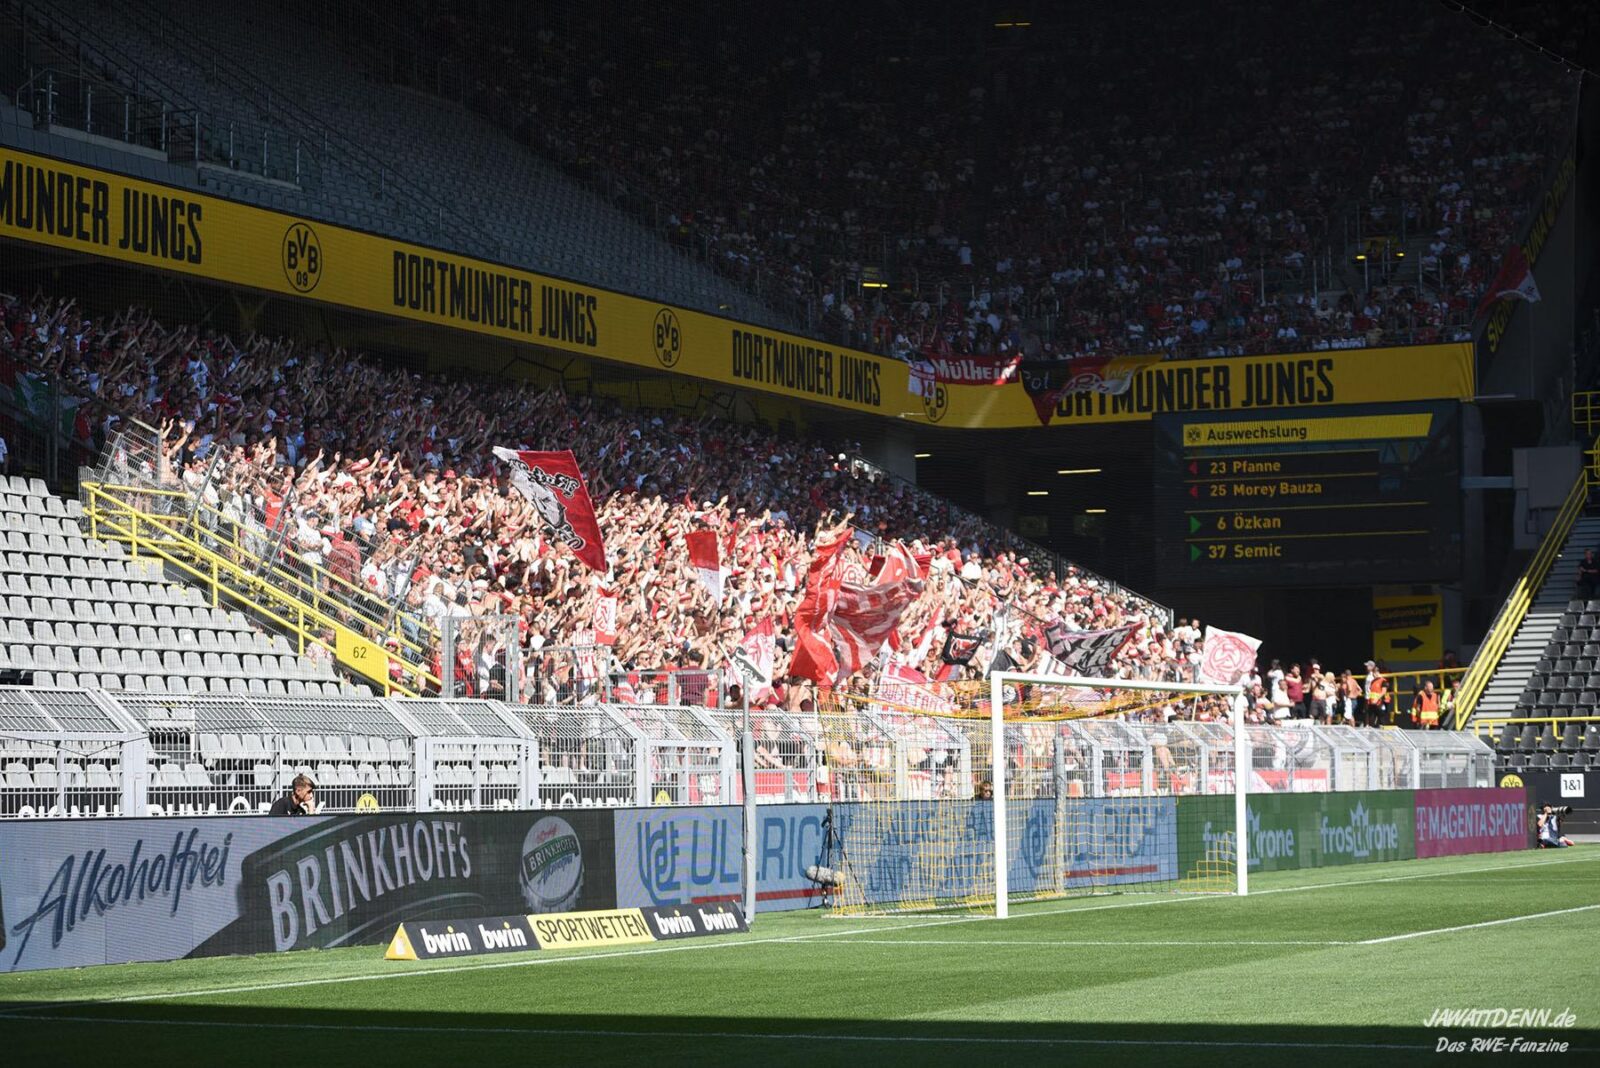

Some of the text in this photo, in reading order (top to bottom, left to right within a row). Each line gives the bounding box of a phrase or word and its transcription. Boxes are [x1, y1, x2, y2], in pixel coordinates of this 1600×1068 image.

[119, 187, 202, 264] JUNGS
[287, 227, 318, 273] BVB
[296, 271, 309, 286] 09
[393, 250, 598, 348] DORTMUNDER JUNGS
[657, 313, 679, 349] BVB
[663, 349, 673, 362] 09
[732, 329, 834, 396] DORTMUNDER
[838, 354, 881, 408] JUNGS
[1241, 359, 1334, 408] JUNGS
[1207, 424, 1307, 442] Auswechslung
[1210, 460, 1281, 474] 23 Pfanne
[1210, 482, 1322, 498] 25 Morey Bauza
[1217, 512, 1282, 530] 6 Özkan
[1208, 543, 1282, 559] 37 Semic
[353, 646, 367, 659] 62
[1563, 779, 1581, 791] 1&1
[1429, 804, 1488, 841] MAGENTA
[1488, 802, 1525, 837] SPORT
[12, 827, 232, 968] Alkoholfrei
[420, 925, 471, 954] bwin
[478, 921, 528, 950] bwin
[536, 913, 649, 944] SPORTWETTEN
[654, 909, 696, 935] bwin
[700, 906, 739, 932] bwin
